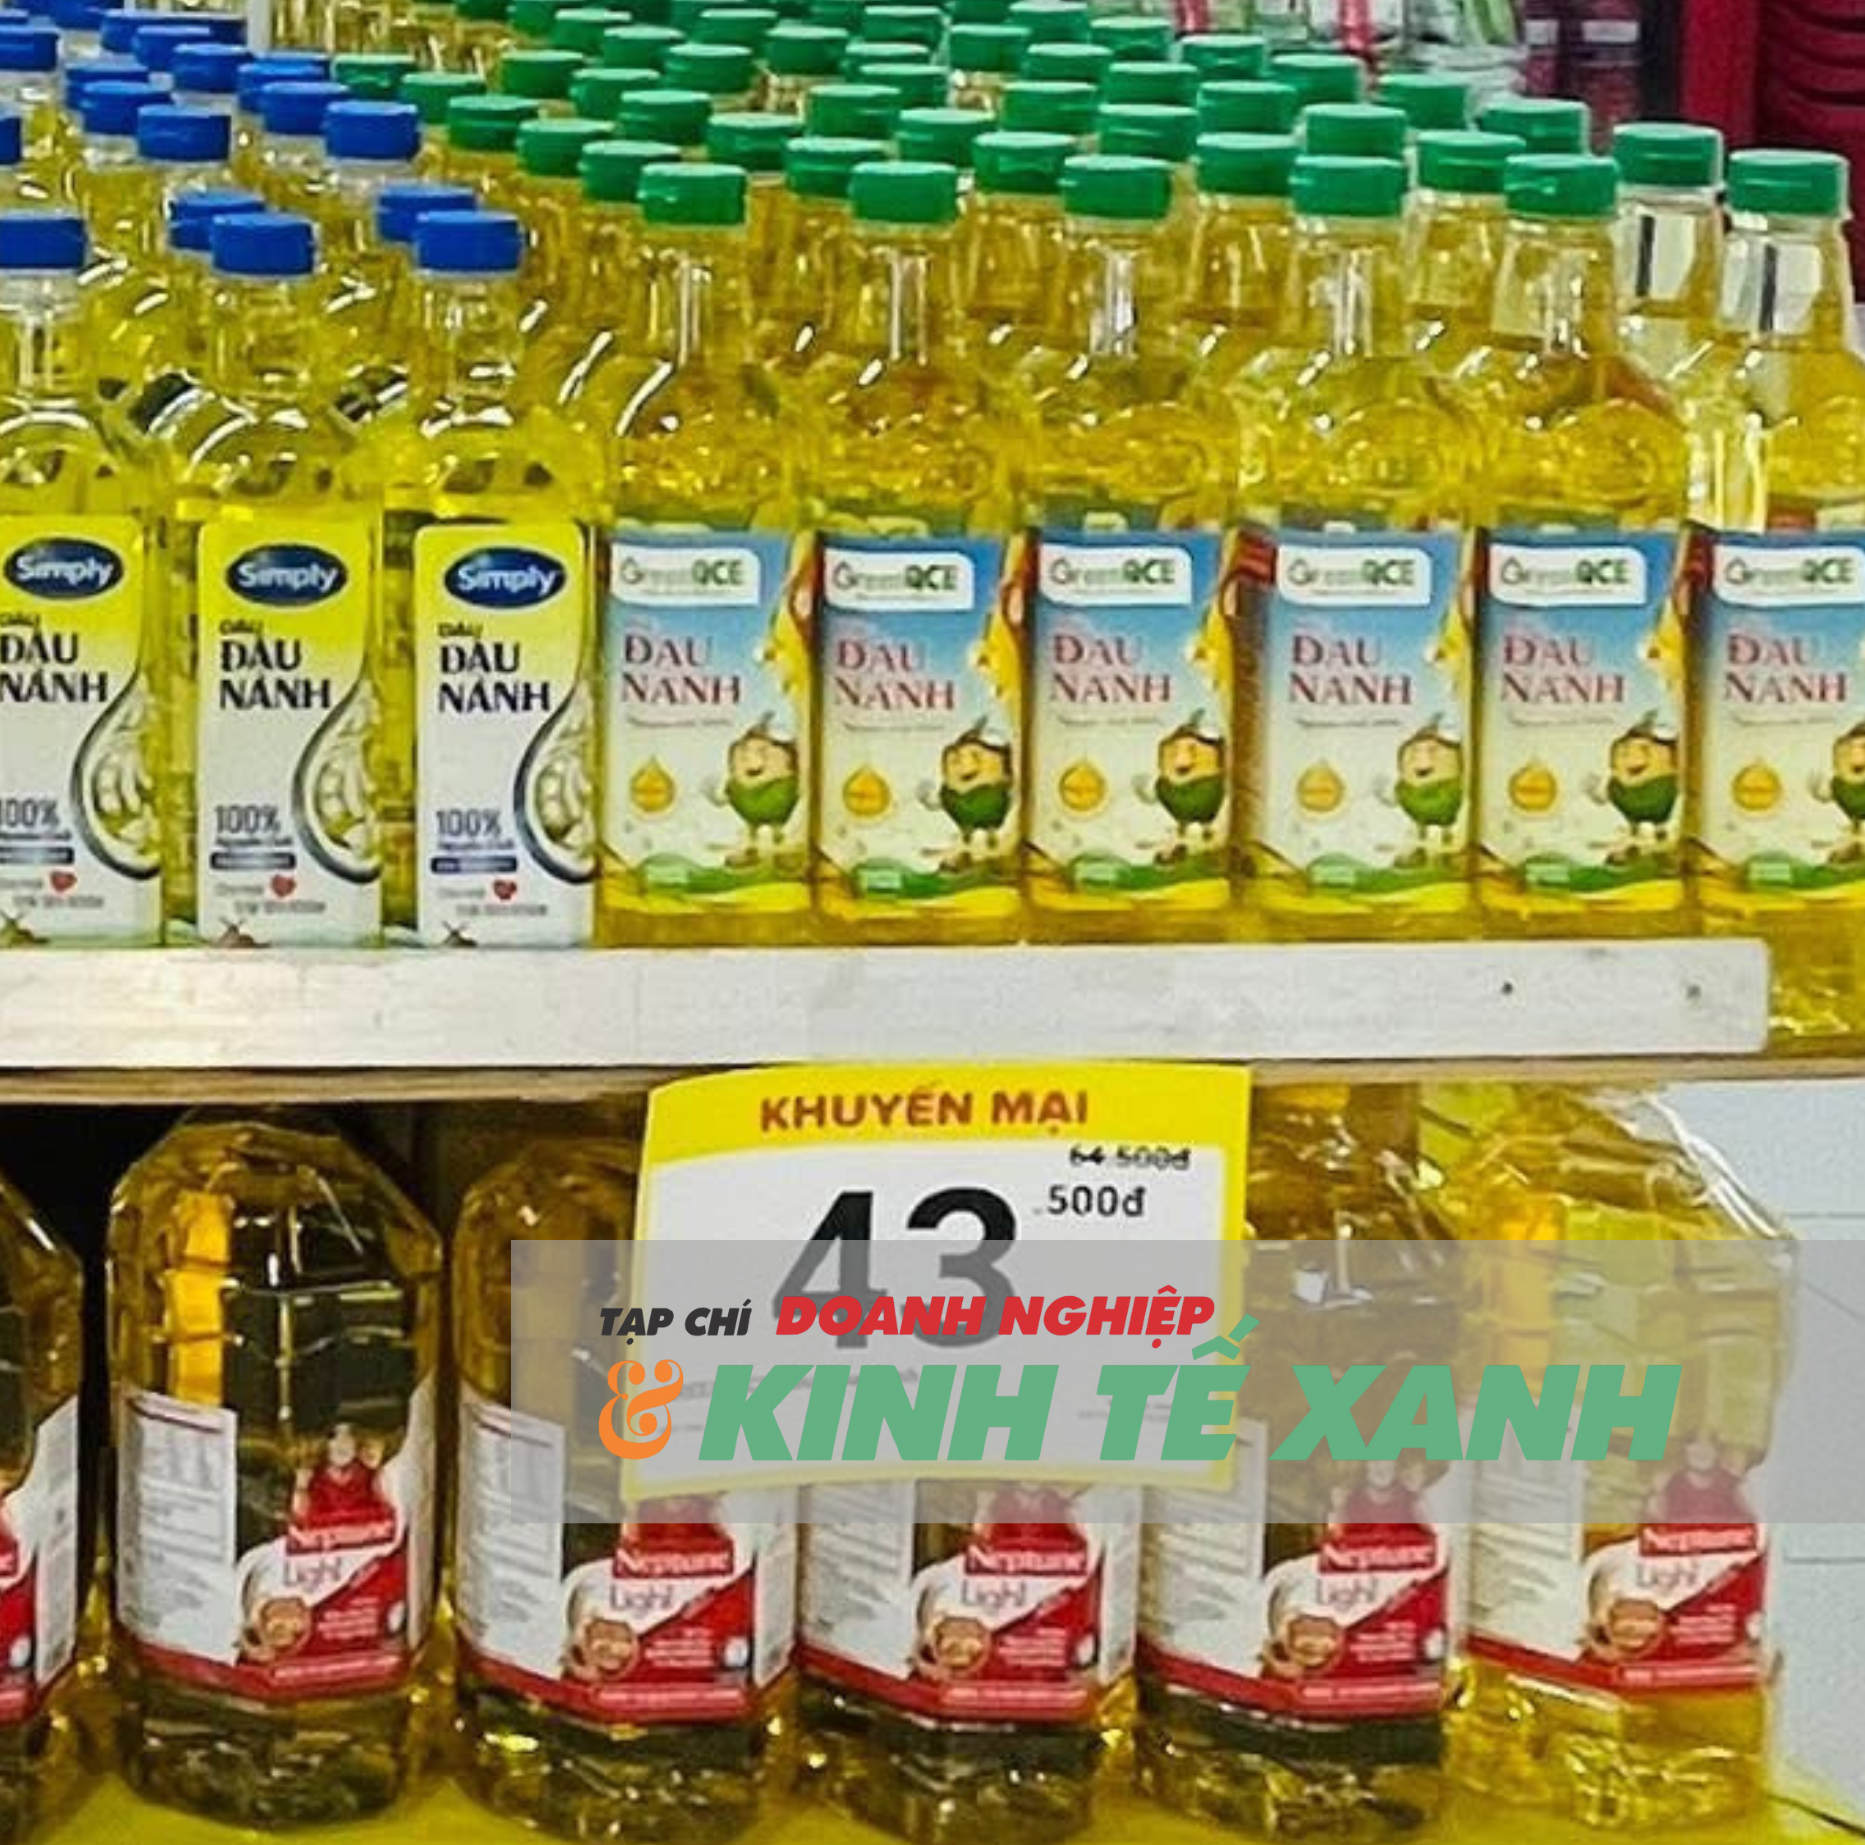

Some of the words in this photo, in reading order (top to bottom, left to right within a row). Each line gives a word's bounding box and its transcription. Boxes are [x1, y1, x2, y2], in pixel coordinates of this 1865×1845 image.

[16, 553, 115, 586] Simply
[239, 558, 339, 592] Simply
[457, 561, 558, 595] Simply
[214, 805, 281, 834] 100%
[435, 809, 501, 838] 100%
[760, 1079, 973, 1134] KHUYẾN
[992, 1089, 1089, 1136] MẠI
[771, 1187, 1018, 1351] 43
